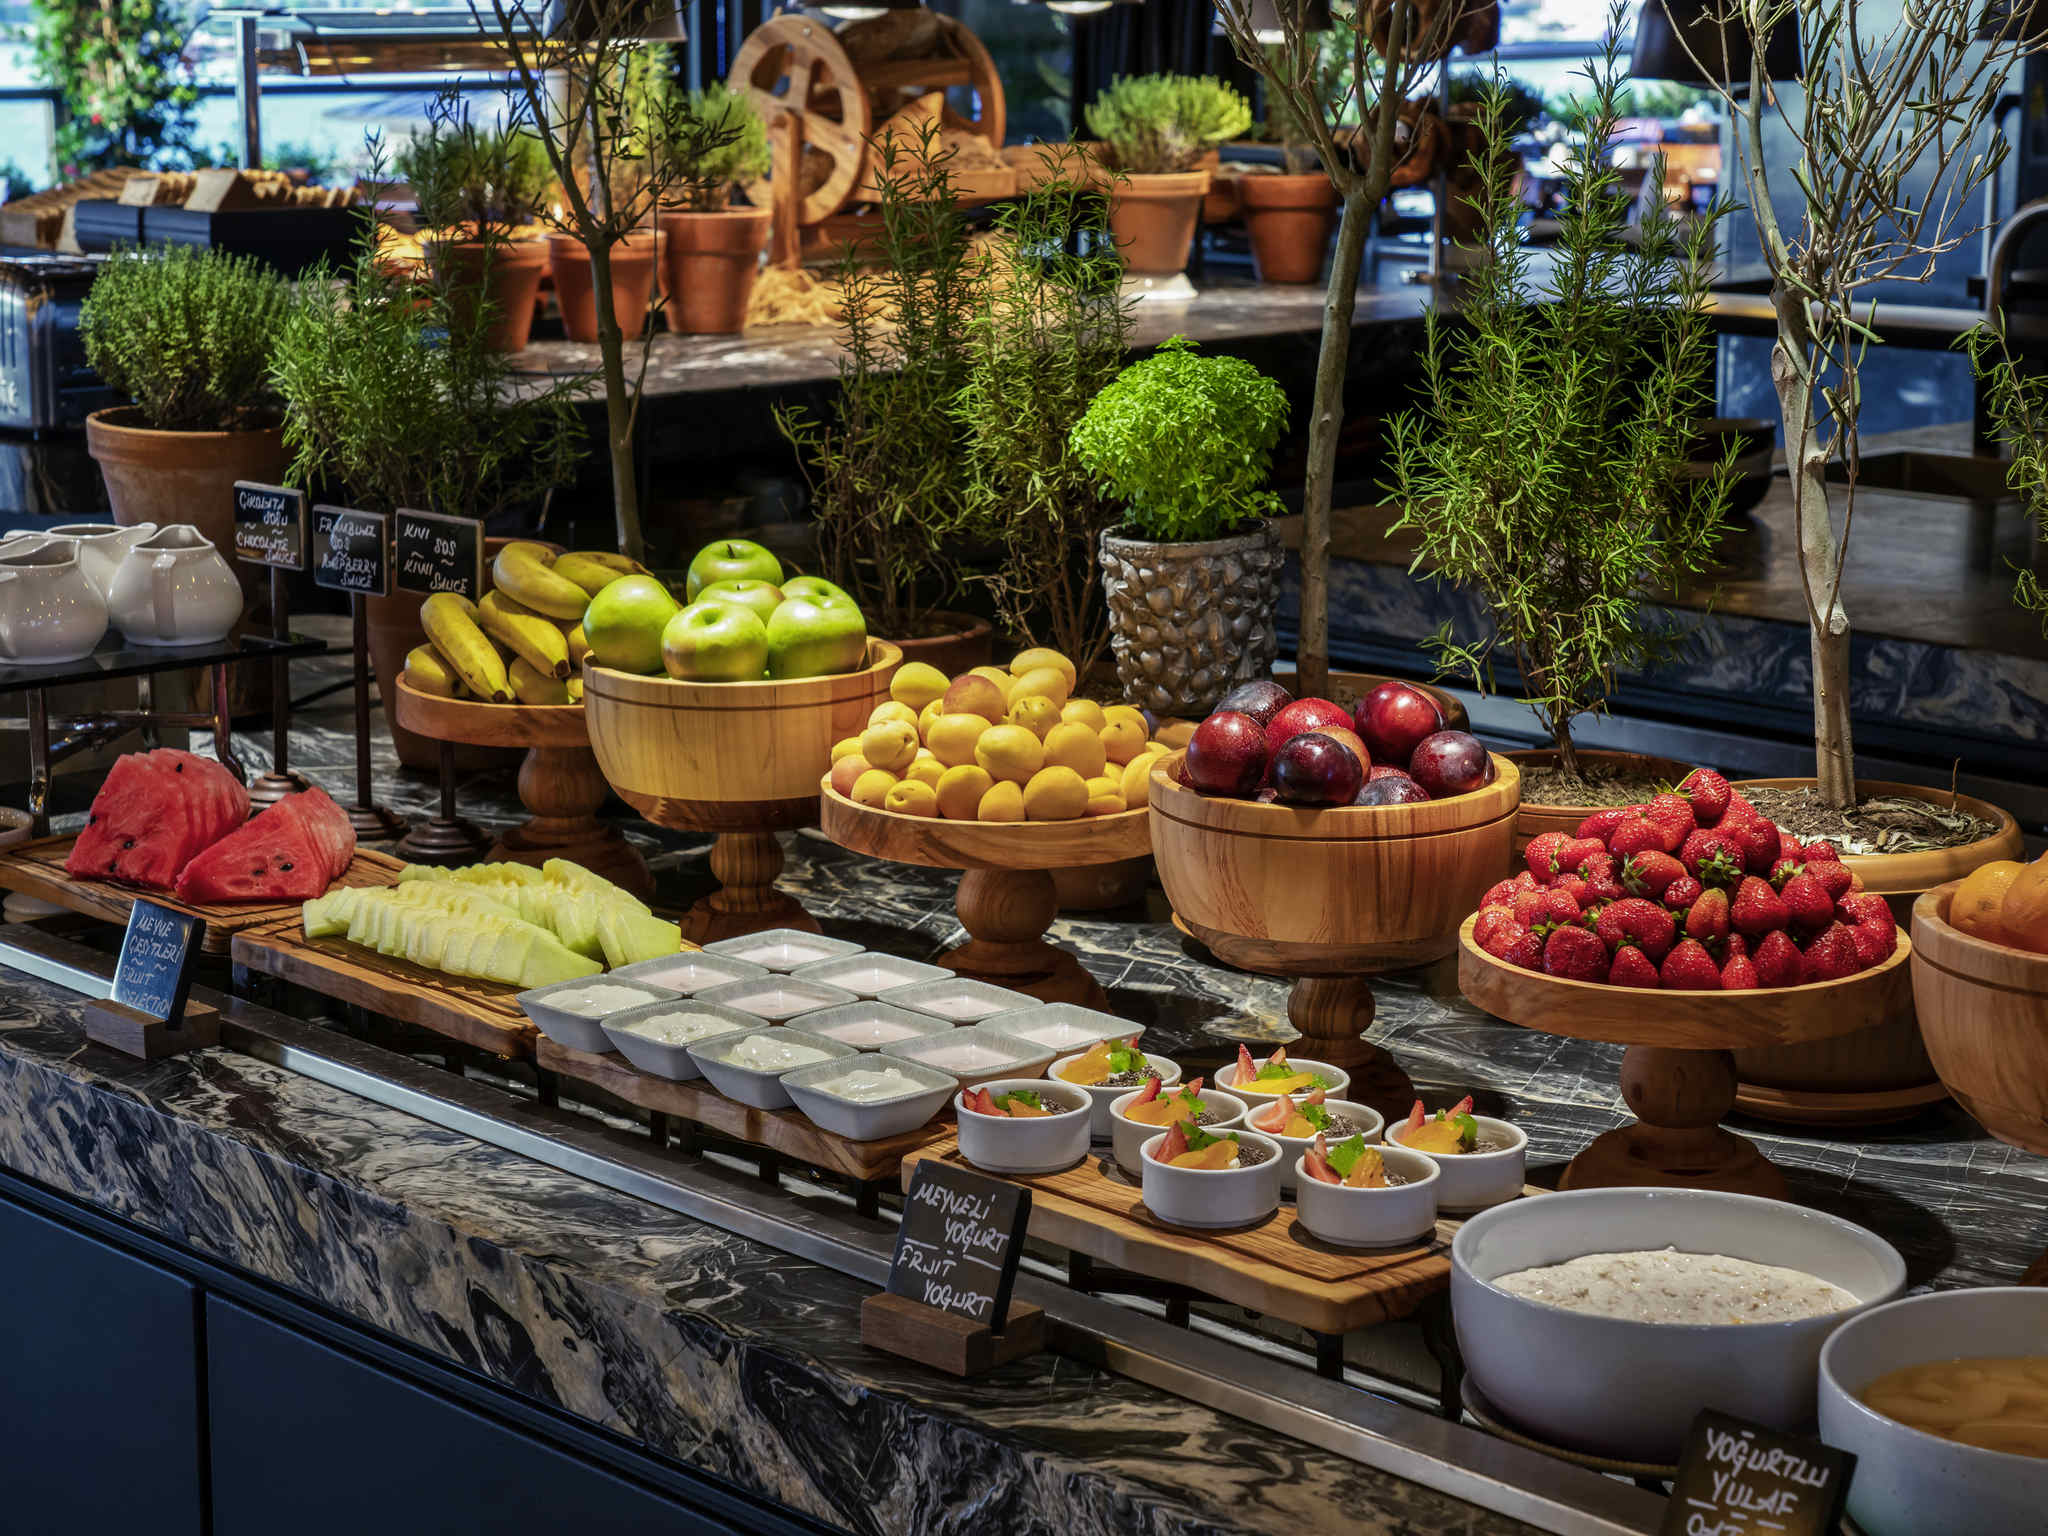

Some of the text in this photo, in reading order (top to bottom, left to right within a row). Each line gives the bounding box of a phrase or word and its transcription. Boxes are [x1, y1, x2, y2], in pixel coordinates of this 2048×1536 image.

[265, 548, 297, 565] SAUCE
[434, 537, 457, 557] SOS
[340, 571, 373, 588] SAUCE
[430, 572, 469, 594] SAUCE
[136, 914, 174, 937] MEYVE
[119, 964, 154, 986] FRUIT
[923, 1278, 995, 1317] YOGURT
[1711, 1470, 1798, 1516] YULAF
